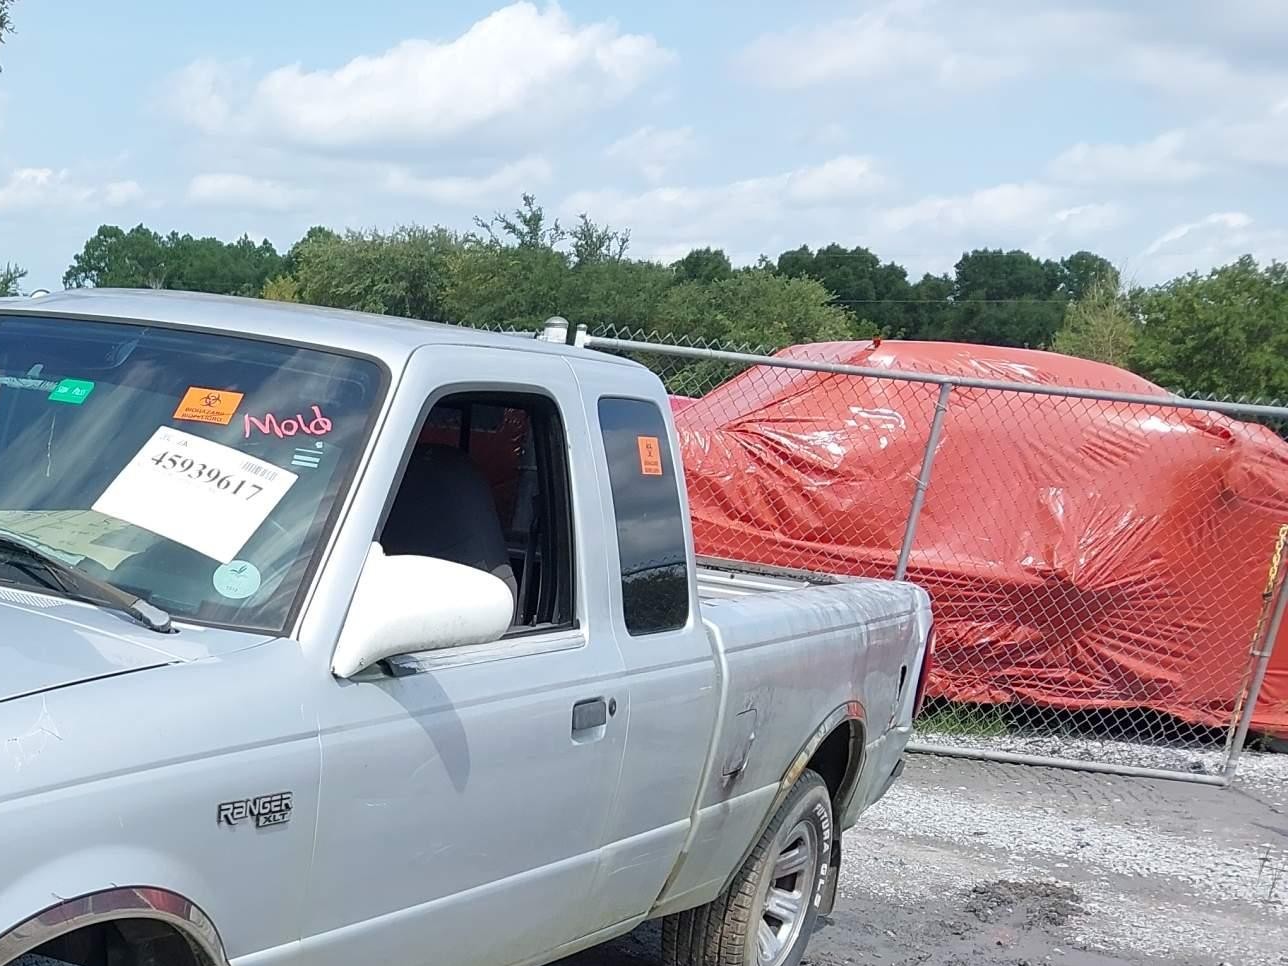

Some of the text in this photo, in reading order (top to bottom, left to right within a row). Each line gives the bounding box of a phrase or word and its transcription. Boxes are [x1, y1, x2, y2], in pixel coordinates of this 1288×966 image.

[244, 405, 332, 438] Mold
[151, 451, 264, 501] 45939617
[217, 791, 293, 825] RANGER
[262, 812, 289, 824] XLT
[812, 803, 830, 853] FUTURA
